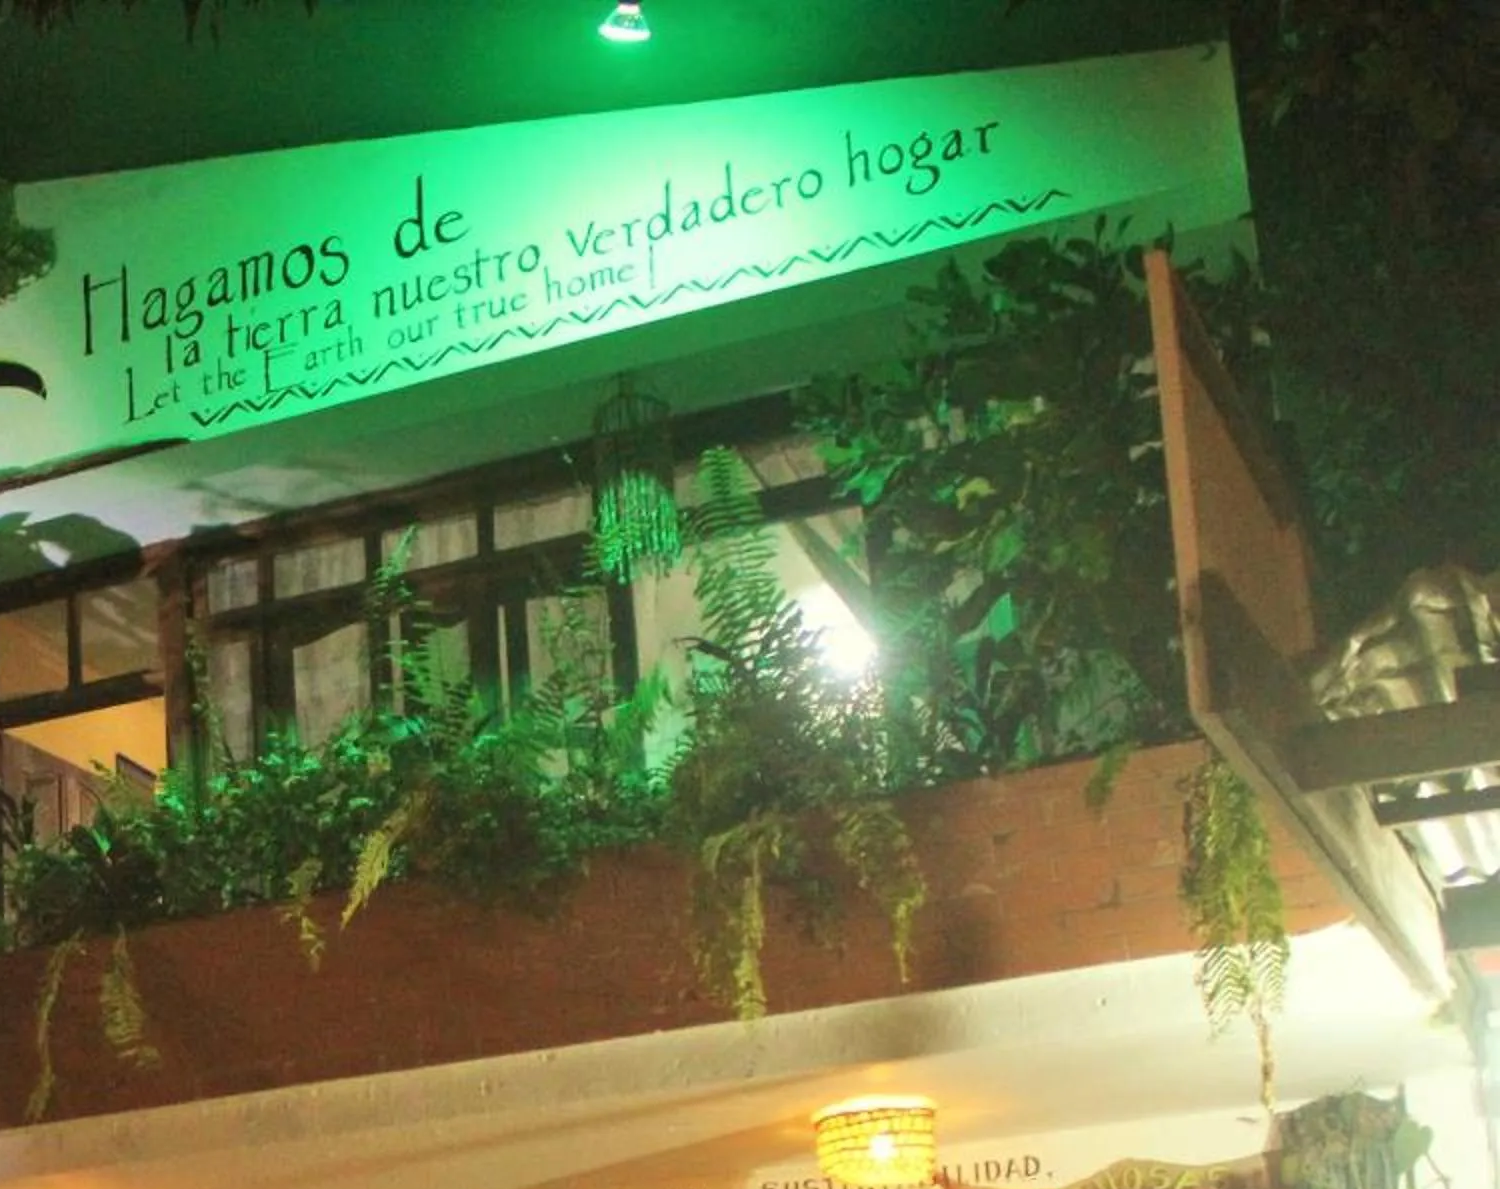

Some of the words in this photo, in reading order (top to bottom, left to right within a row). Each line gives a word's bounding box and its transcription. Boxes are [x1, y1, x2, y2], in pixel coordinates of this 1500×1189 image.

[83, 235, 350, 356] Hagamos
[393, 174, 470, 259] de
[165, 334, 201, 374] la
[226, 298, 345, 359] tierra
[372, 244, 541, 319] nuestro
[845, 121, 999, 196] hogar
[123, 366, 182, 424] Let
[203, 349, 247, 395] the
[260, 325, 363, 394] Earth
[387, 313, 440, 351] our
[454, 291, 529, 330] true
